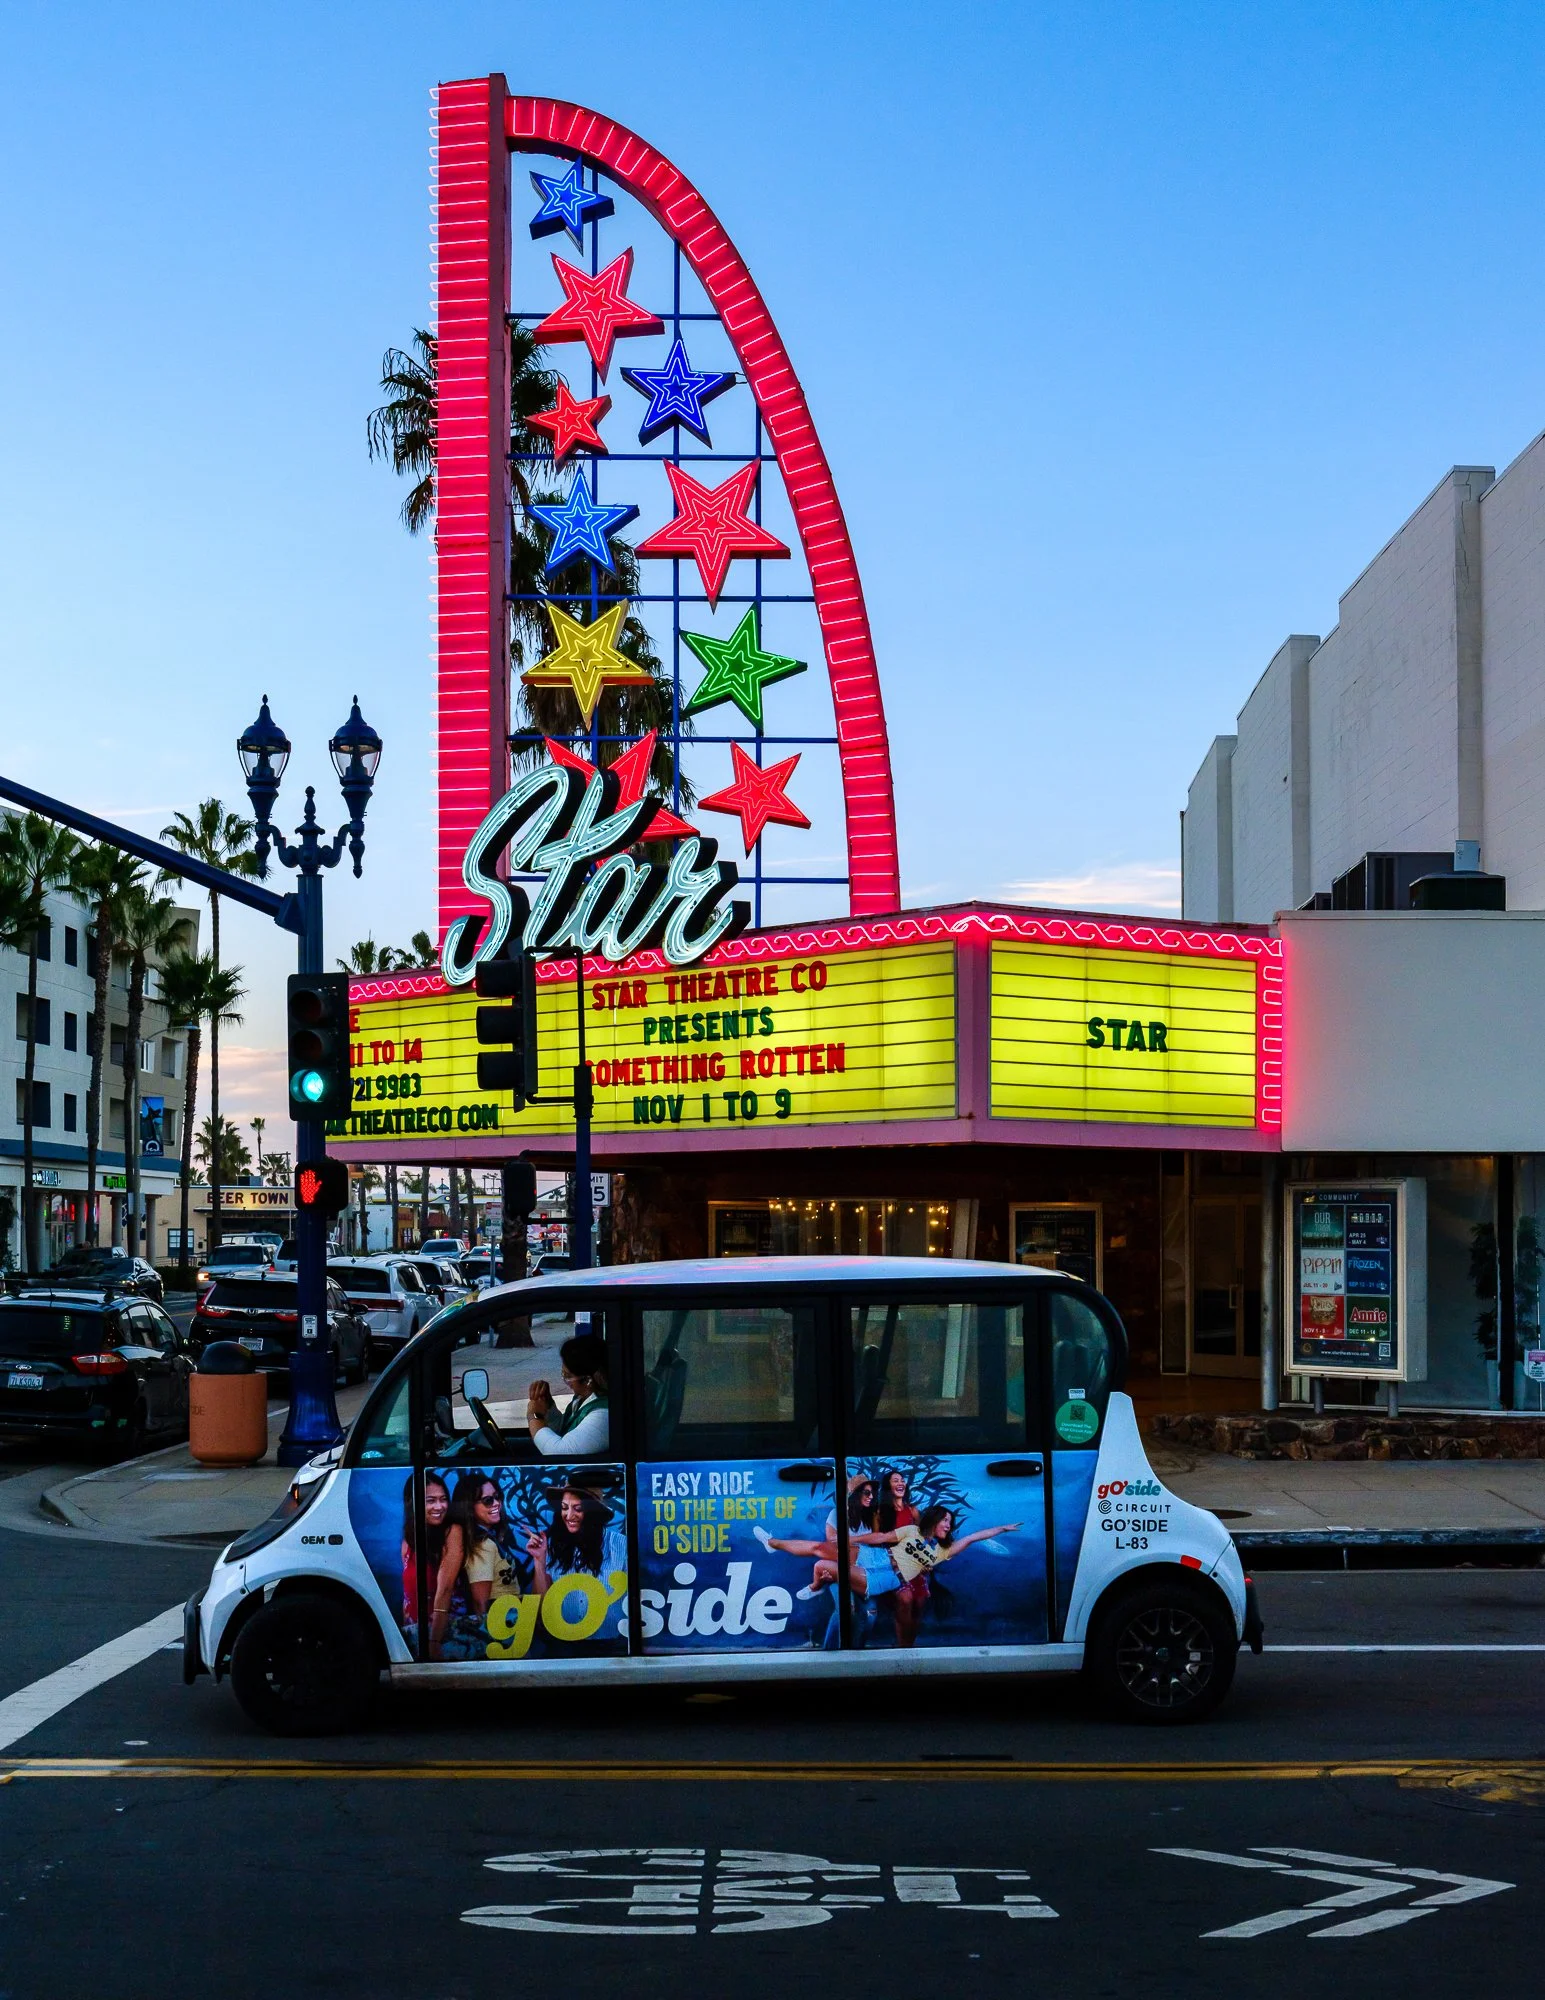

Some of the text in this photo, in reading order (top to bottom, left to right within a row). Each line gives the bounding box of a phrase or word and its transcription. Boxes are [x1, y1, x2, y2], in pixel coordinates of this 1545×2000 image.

[441, 763, 740, 986] Star
[592, 960, 828, 1011] STAR THEATRE CO
[643, 1006, 775, 1046] PRESENTS
[1086, 1016, 1168, 1052] STAR
[370, 1039, 395, 1065] TO
[403, 1038, 422, 1064] 14
[740, 1042, 845, 1080] ROTTEN
[351, 1073, 422, 1101] 21 9983
[633, 1088, 792, 1124] NOV 1 TO 9
[325, 1103, 499, 1136] ARTHEATRECO COM
[207, 1192, 289, 1204] BEER TOWN
[594, 1186, 605, 1202] 5
[1314, 1211, 1331, 1224] OUR
[1347, 1260, 1380, 1271] FROZEN
[1349, 1306, 1388, 1324] Annie
[652, 1471, 755, 1497] EASY RIDE
[652, 1496, 797, 1522] TO THE BEST OF
[1115, 1503, 1172, 1514] CIRCUIT
[653, 1523, 731, 1554] O'SIDE
[1101, 1519, 1168, 1533] GO'SIDE
[301, 1535, 326, 1545] GEM
[1115, 1536, 1149, 1550] L-83
